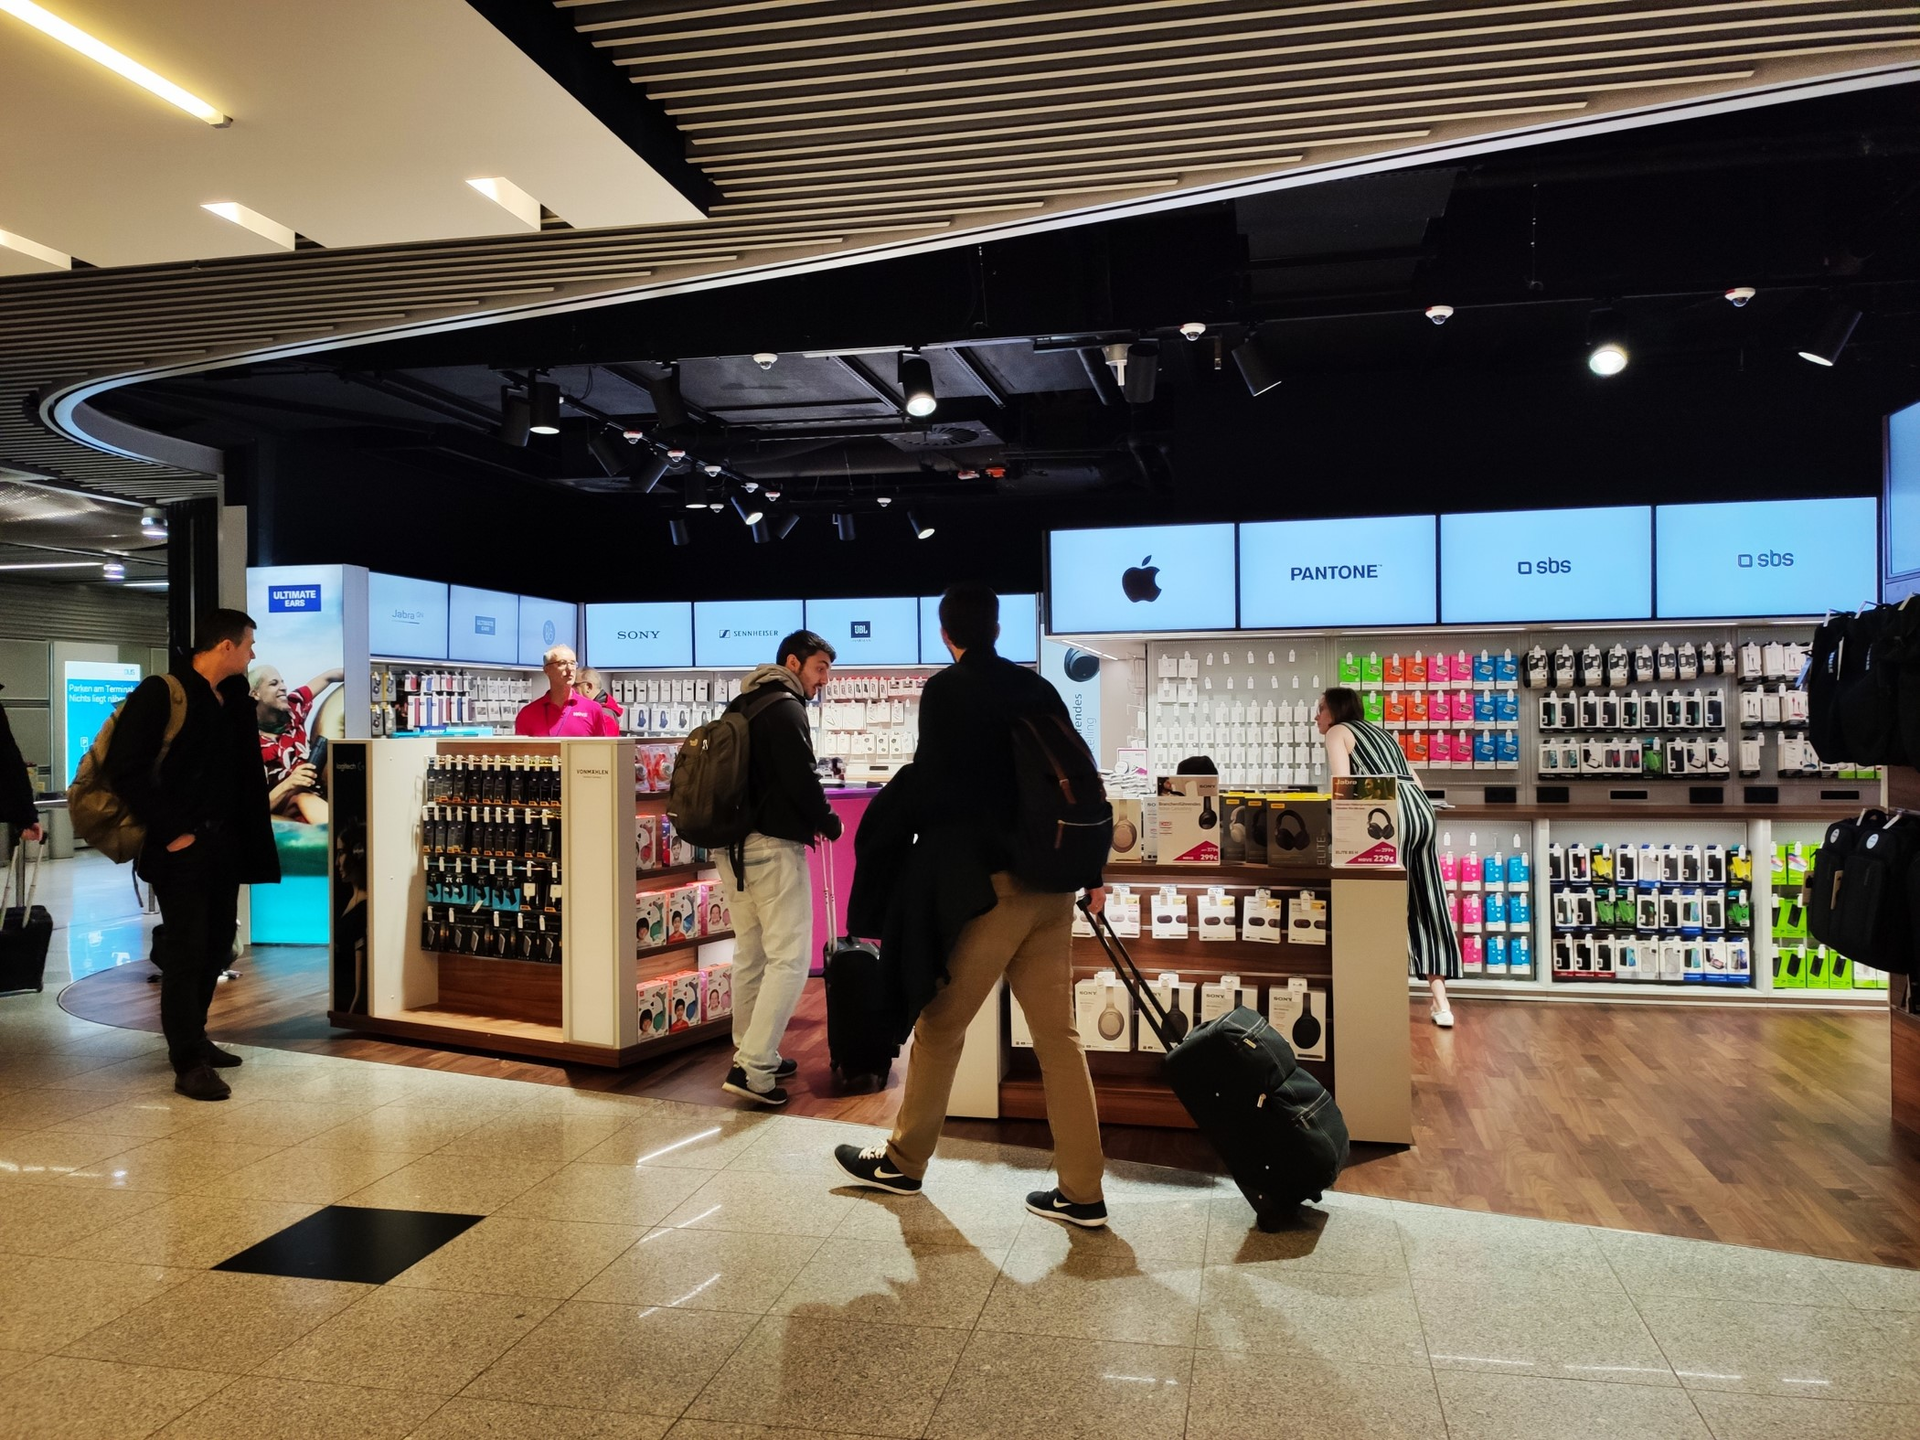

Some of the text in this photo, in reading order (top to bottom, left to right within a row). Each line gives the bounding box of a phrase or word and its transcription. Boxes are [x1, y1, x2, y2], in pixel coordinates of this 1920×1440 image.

[1757, 549, 1794, 567] sbs
[1536, 556, 1571, 574] sbs
[273, 590, 317, 600] ULTIMATE
[284, 599, 305, 607] EARS
[391, 609, 415, 620] Jabra
[854, 624, 868, 634] JBL
[617, 630, 660, 639] SONY
[69, 683, 93, 693] Parken
[69, 694, 91, 703] Nichts
[92, 694, 106, 705] liegt
[1334, 778, 1358, 786] Jabra
[1316, 836, 1327, 866] ELITE
[1373, 854, 1395, 863] 229€
